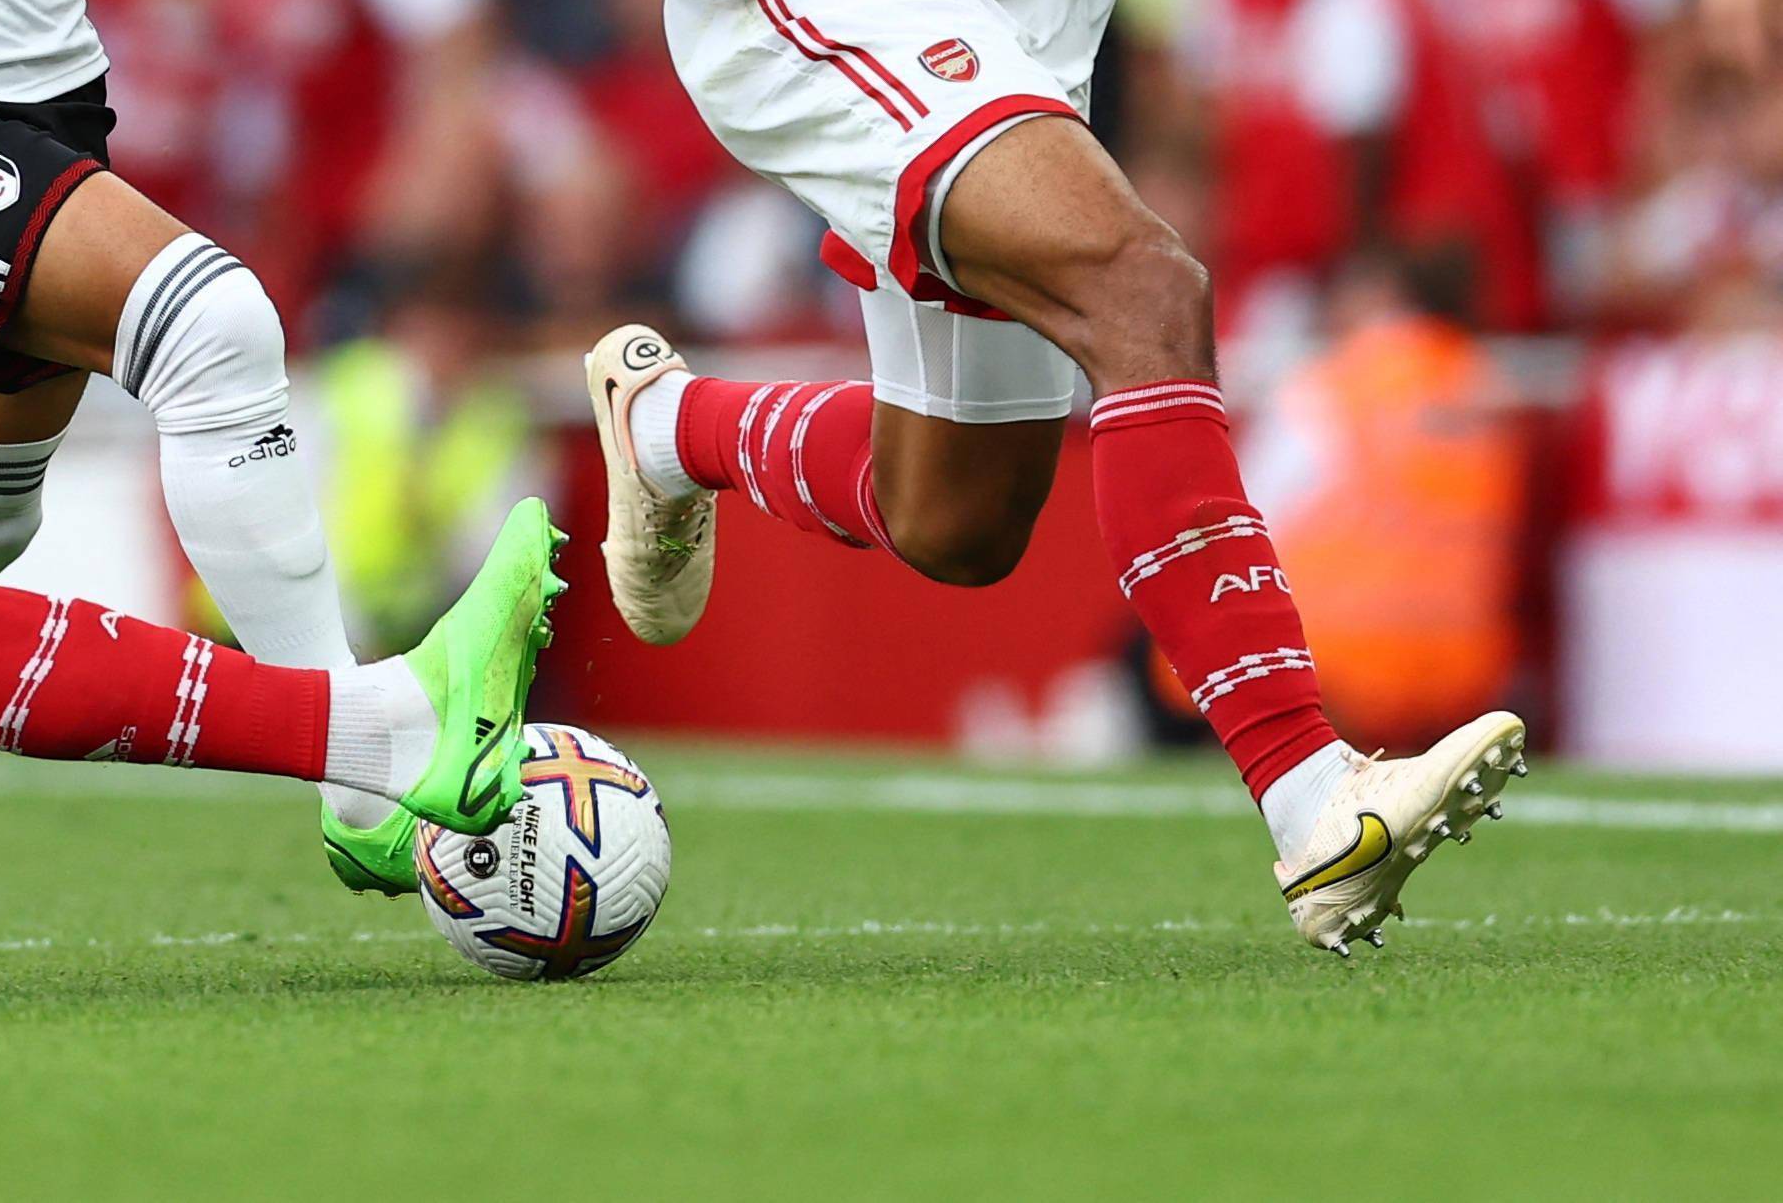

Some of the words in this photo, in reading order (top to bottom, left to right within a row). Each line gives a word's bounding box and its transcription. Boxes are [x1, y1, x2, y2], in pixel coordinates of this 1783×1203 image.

[228, 437, 297, 468] adida
[510, 808, 524, 861] PREMIER
[523, 804, 541, 847] NIKE
[472, 852, 490, 864] 5
[509, 862, 519, 910] LEAGUE
[520, 848, 537, 917] FLIGHT
